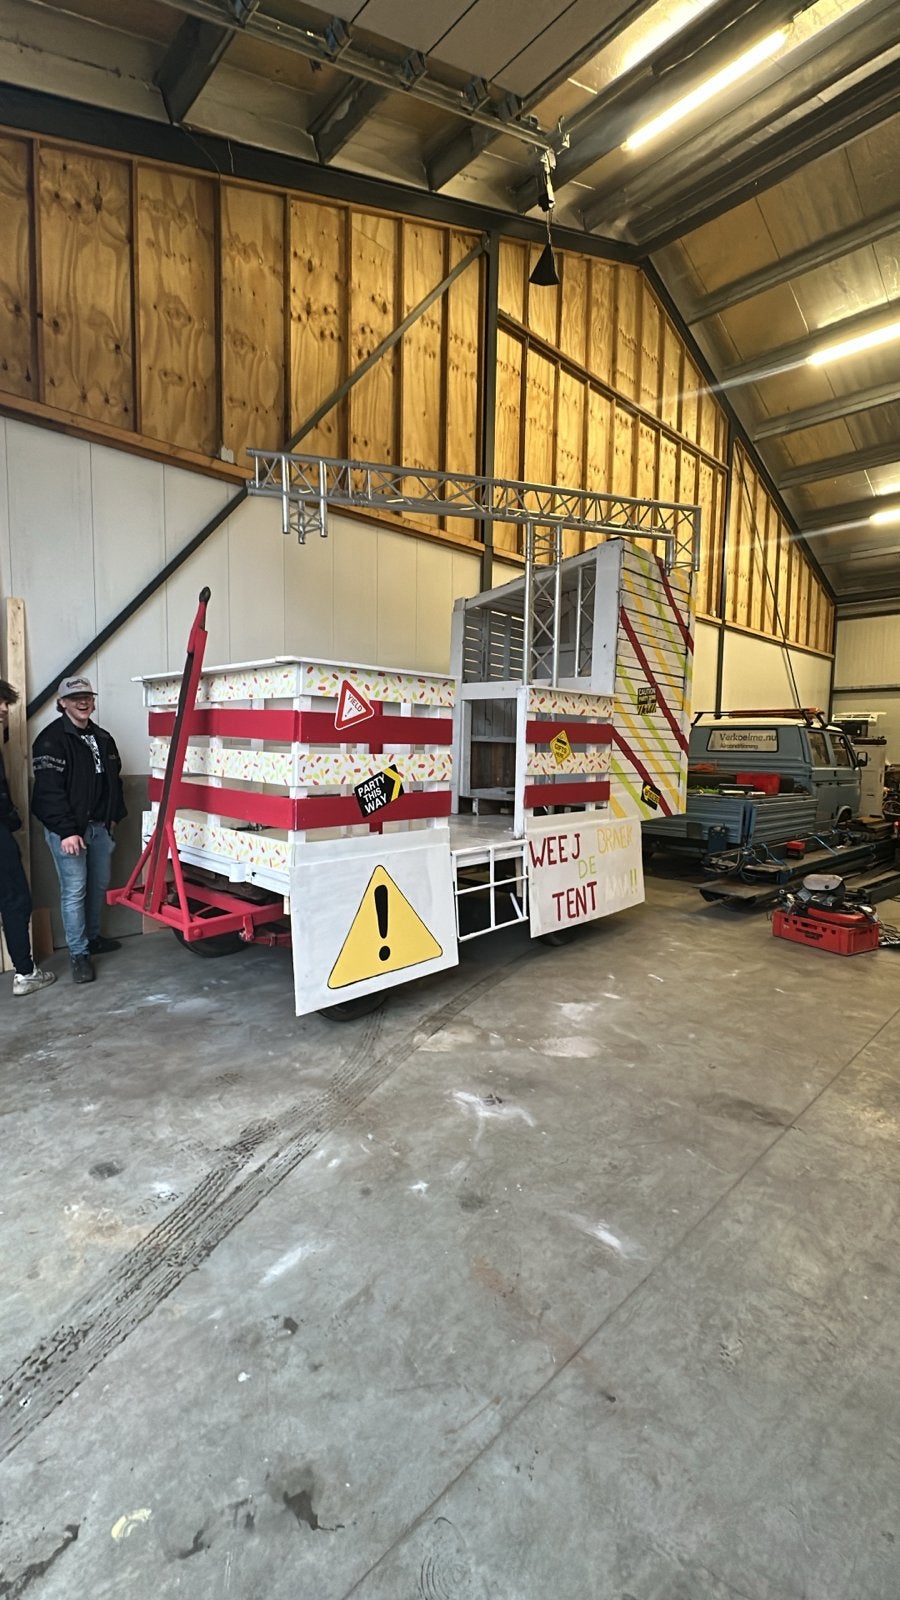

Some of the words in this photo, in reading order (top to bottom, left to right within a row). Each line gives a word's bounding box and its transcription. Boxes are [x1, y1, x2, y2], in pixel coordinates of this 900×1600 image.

[348, 694, 362, 712] YIELD
[720, 733, 777, 741] Verkoelme.nu
[554, 743, 567, 754] GIFTS
[358, 774, 385, 797] PARTY
[363, 787, 382, 803] THIS
[365, 793, 387, 813] WAY
[529, 833, 581, 868] WEEJ
[578, 855, 597, 879] DE
[552, 881, 597, 921] TENT
